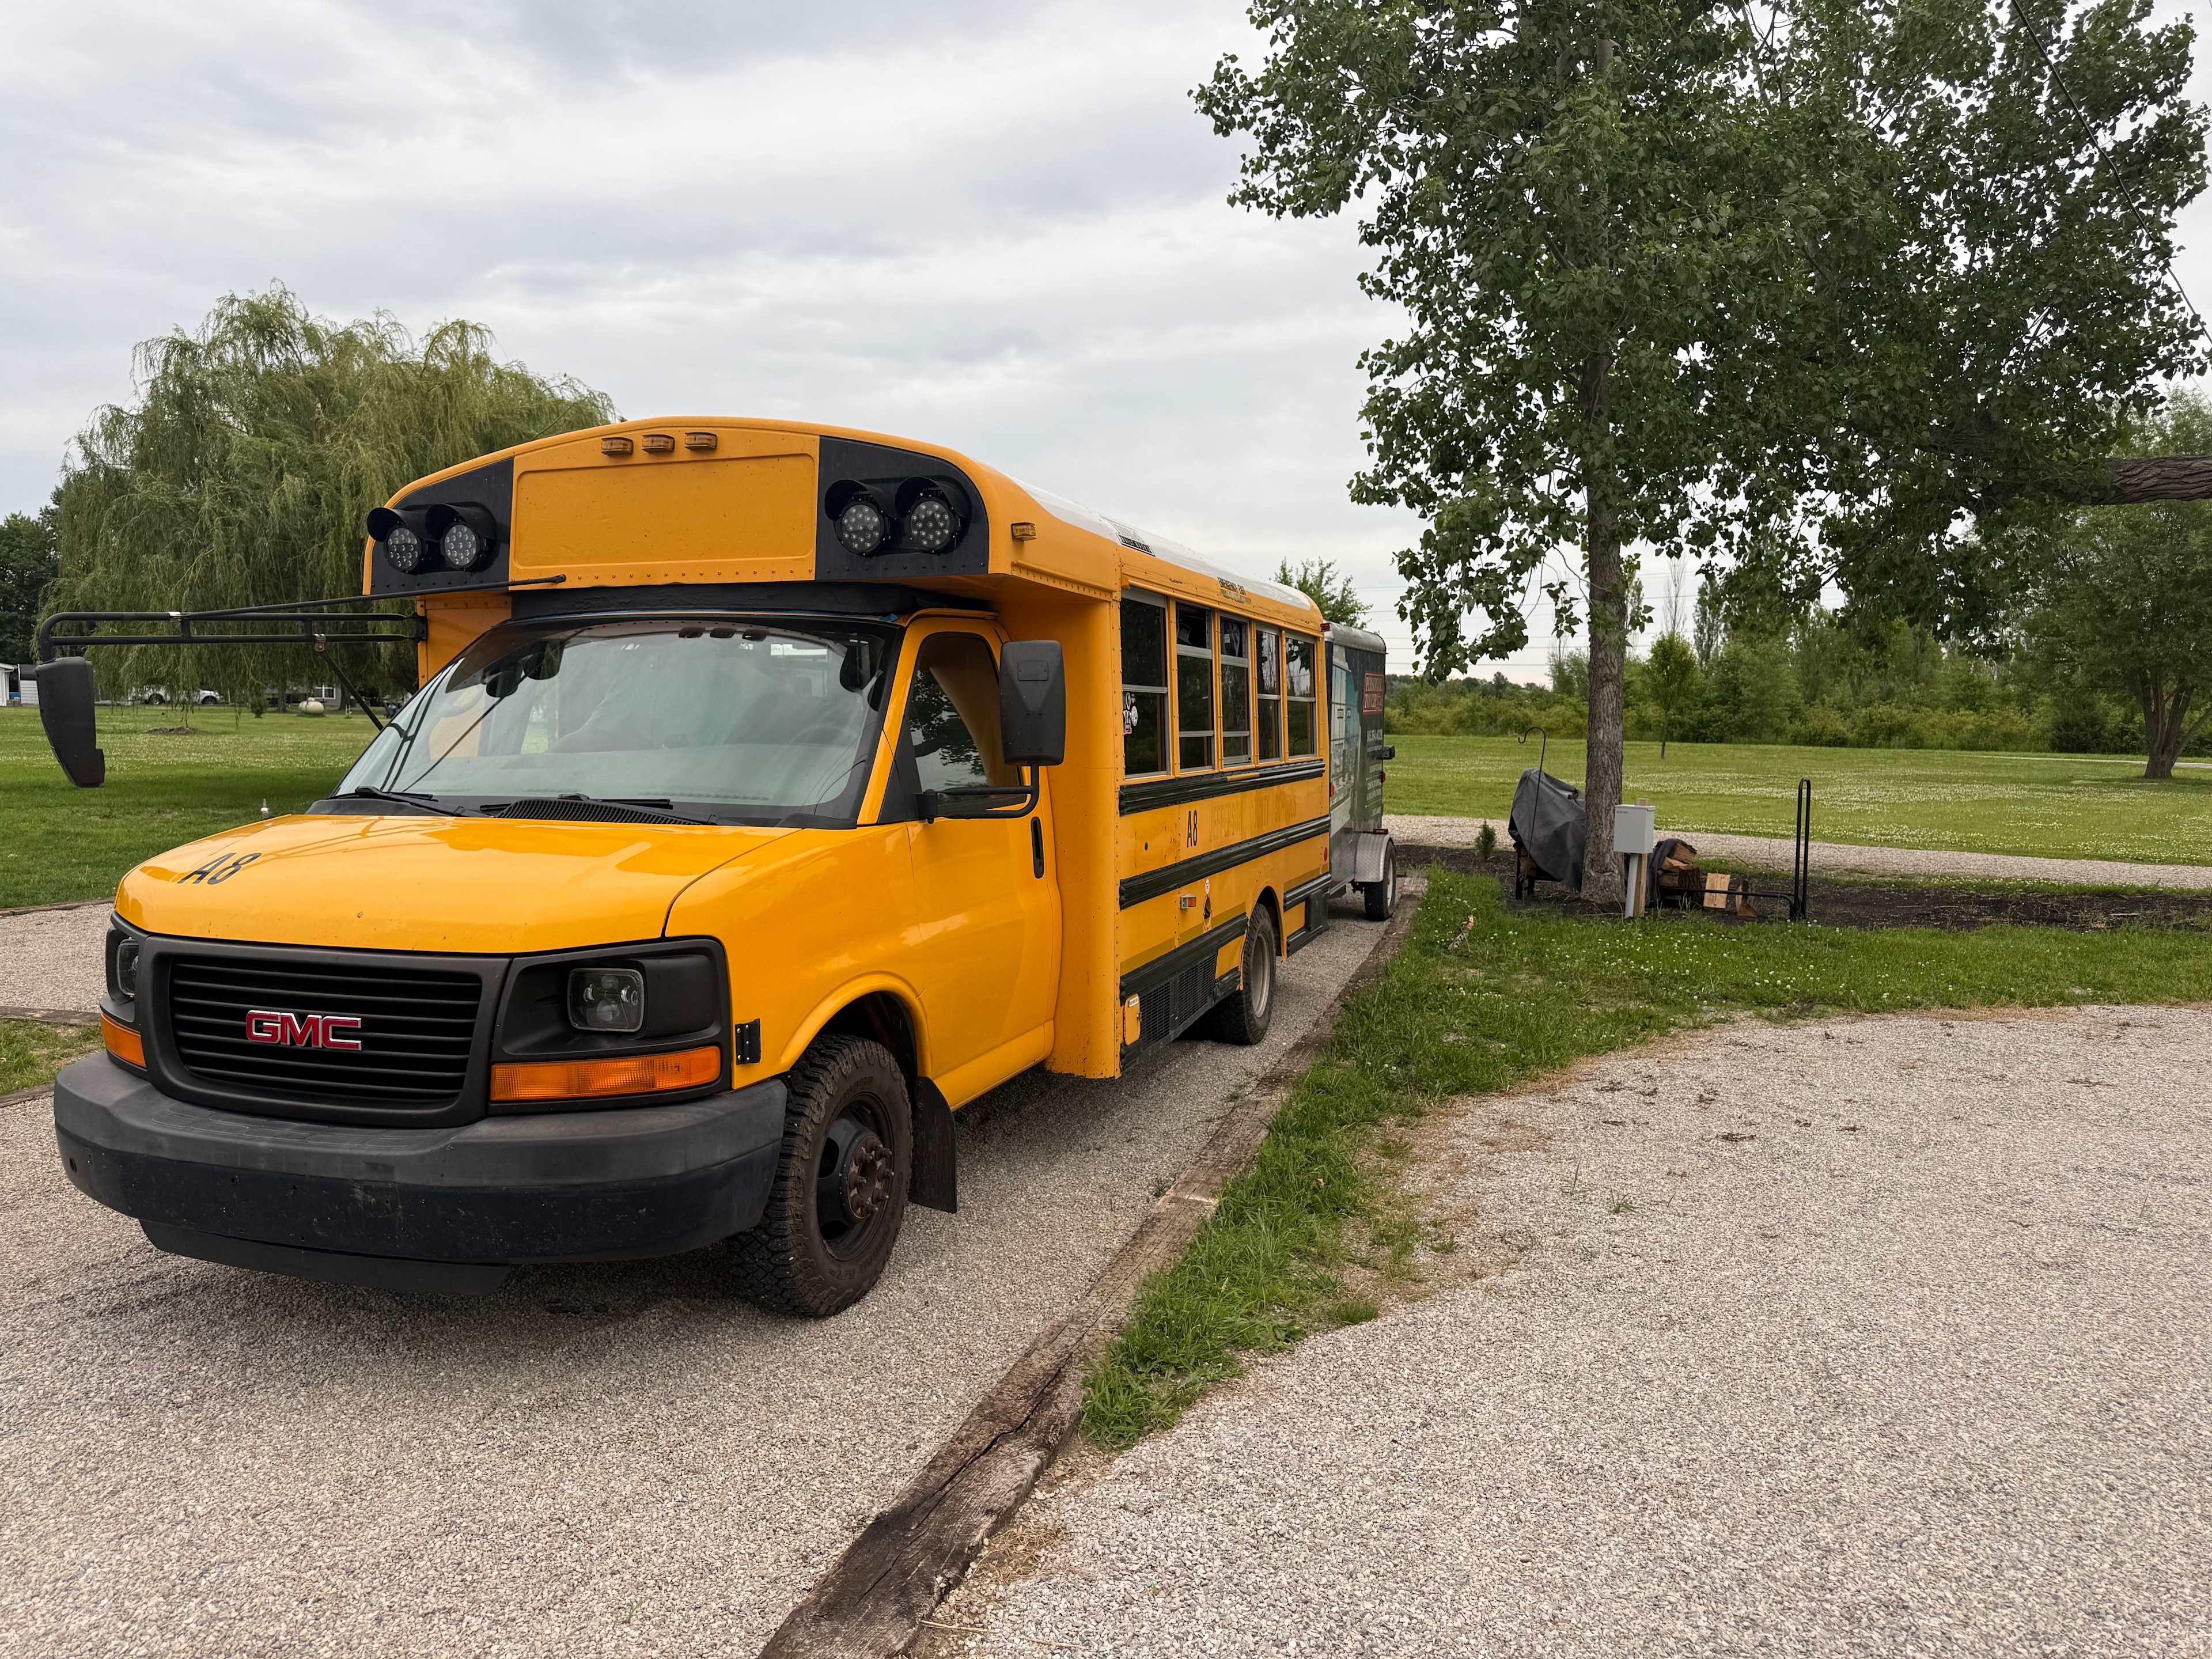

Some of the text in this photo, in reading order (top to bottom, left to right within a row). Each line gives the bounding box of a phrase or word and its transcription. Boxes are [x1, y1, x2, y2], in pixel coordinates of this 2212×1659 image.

[1187, 809, 1198, 848] A8
[177, 852, 262, 885] A8
[246, 1009, 362, 1051] GMC
